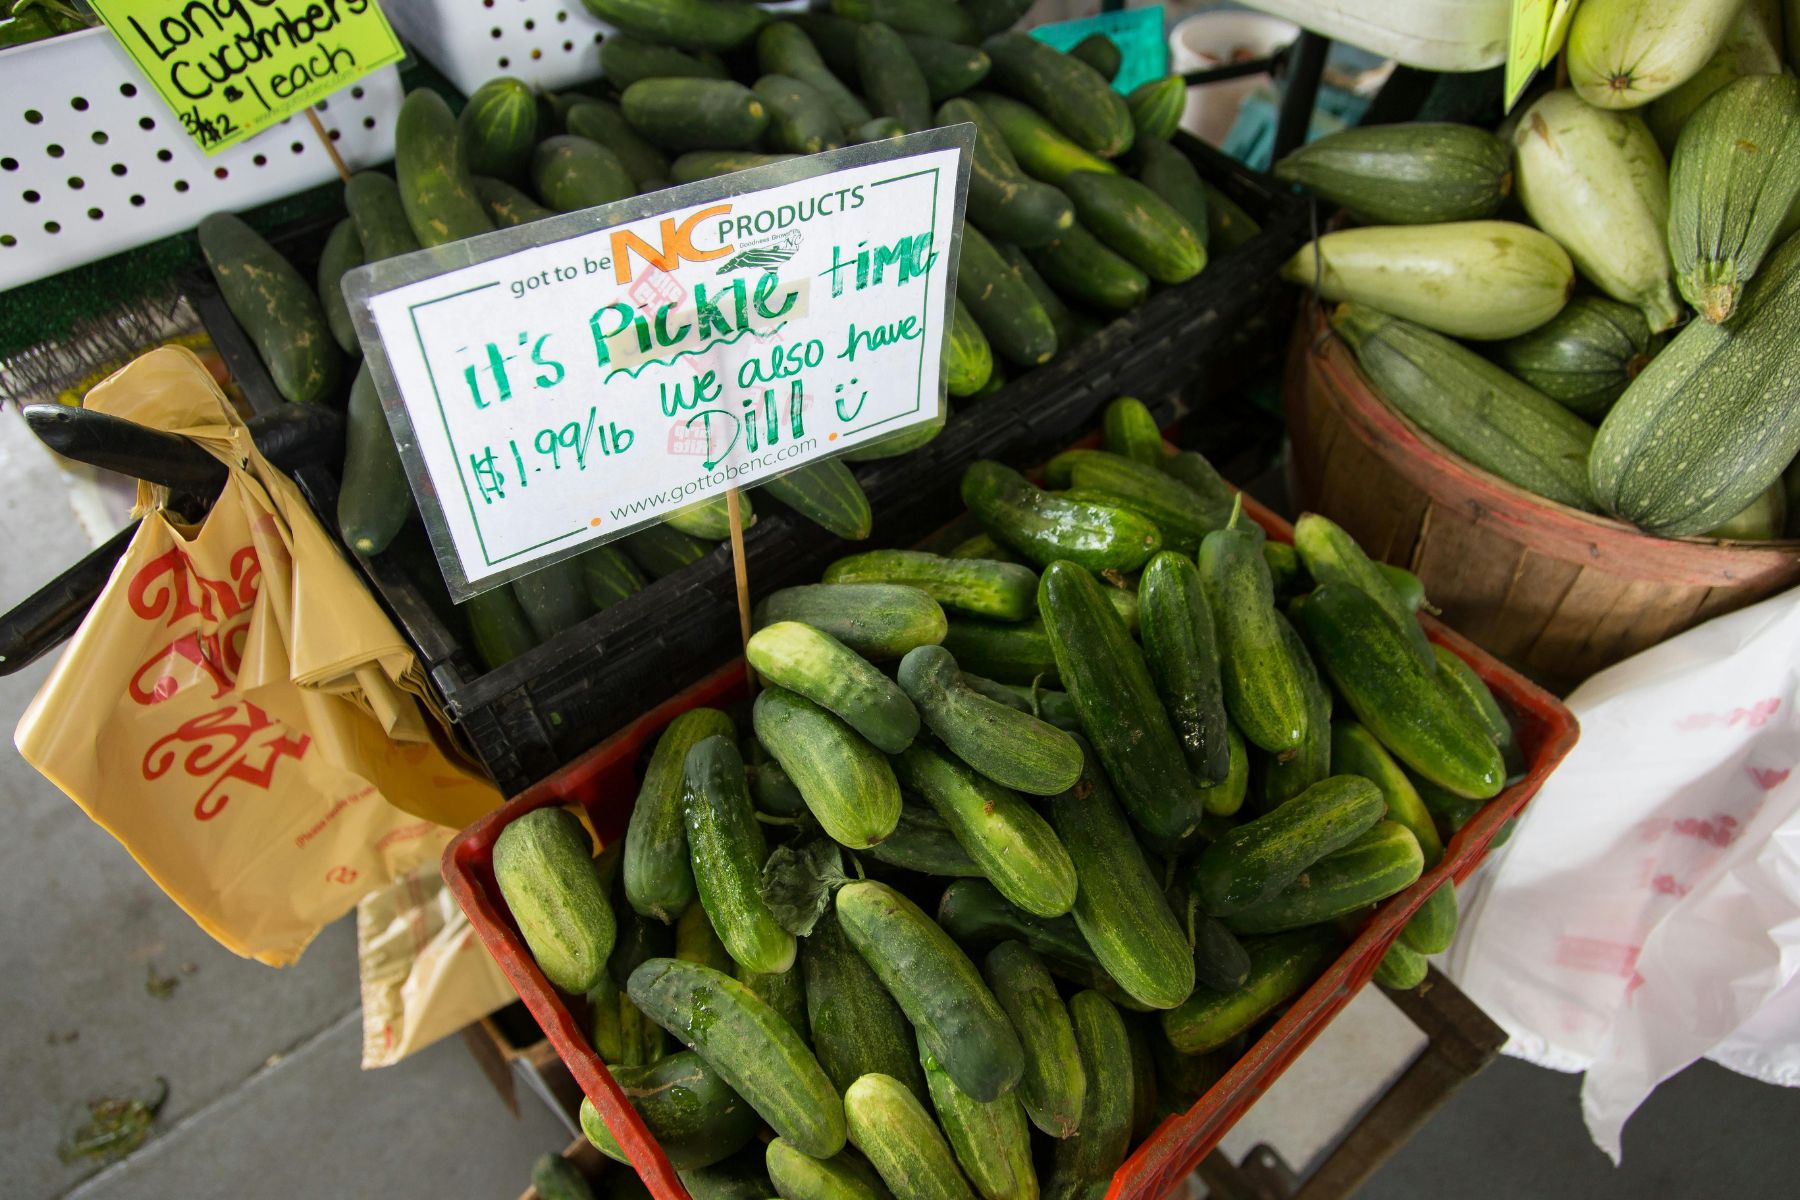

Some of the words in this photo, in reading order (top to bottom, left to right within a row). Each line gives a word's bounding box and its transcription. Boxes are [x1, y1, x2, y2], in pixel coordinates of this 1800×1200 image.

[127, 0, 256, 61] Long
[170, 0, 368, 99] Cucumbers
[270, 43, 356, 98] each
[510, 272, 550, 299] got
[556, 264, 579, 284] to
[584, 253, 612, 276] be
[609, 203, 736, 286] NC
[717, 185, 866, 244] PRODUCTS
[589, 272, 799, 368] Pickle
[737, 339, 825, 389] also
[836, 315, 924, 362] have
[686, 379, 805, 472] Dill
[609, 438, 818, 521] www.gottobenc.com
[127, 544, 261, 629] Tha
